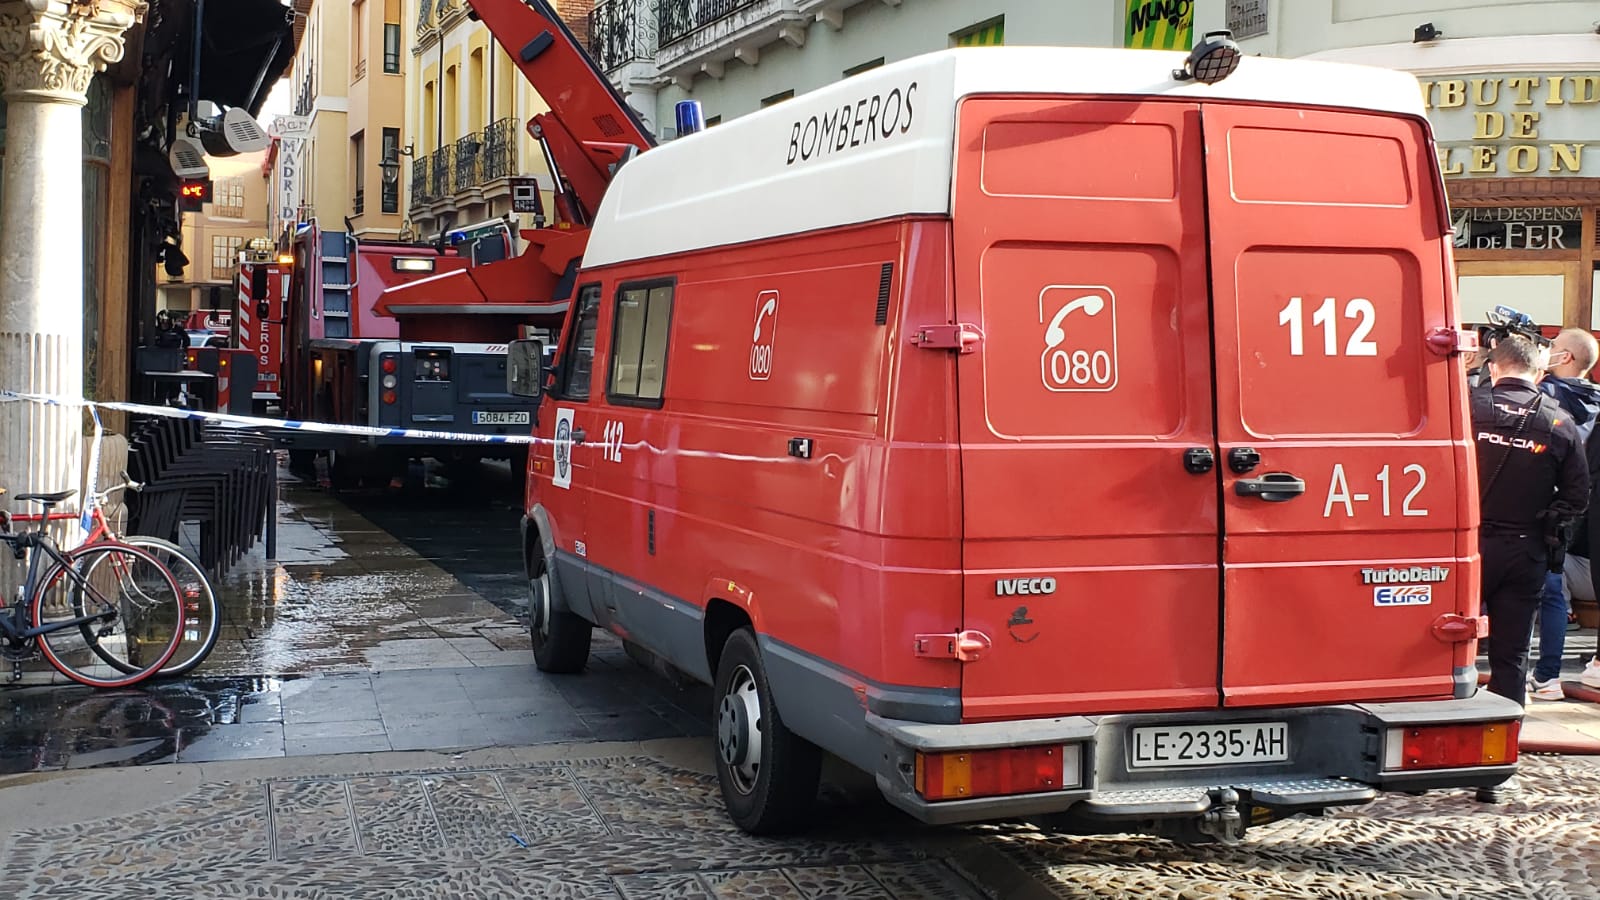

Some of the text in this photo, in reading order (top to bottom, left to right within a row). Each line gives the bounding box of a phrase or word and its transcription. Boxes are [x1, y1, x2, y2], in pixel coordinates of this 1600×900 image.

[273, 117, 307, 134] Bar
[787, 81, 917, 165] BOMBEROS
[1473, 111, 1539, 140] DE
[1439, 143, 1585, 174] LEON
[283, 138, 295, 219] MADRID
[1473, 206, 1582, 222] LA DESPENSA
[1477, 222, 1566, 250] DE FER
[1279, 297, 1378, 356] 112
[752, 345, 771, 374] 080
[1051, 350, 1111, 384] 080
[479, 413, 528, 423] 5084 FZD
[603, 420, 624, 463] 112
[1323, 463, 1429, 518] A-12
[996, 577, 1057, 595] IVECO
[1361, 565, 1450, 583] TurboDaily
[1376, 588, 1430, 603] Euro
